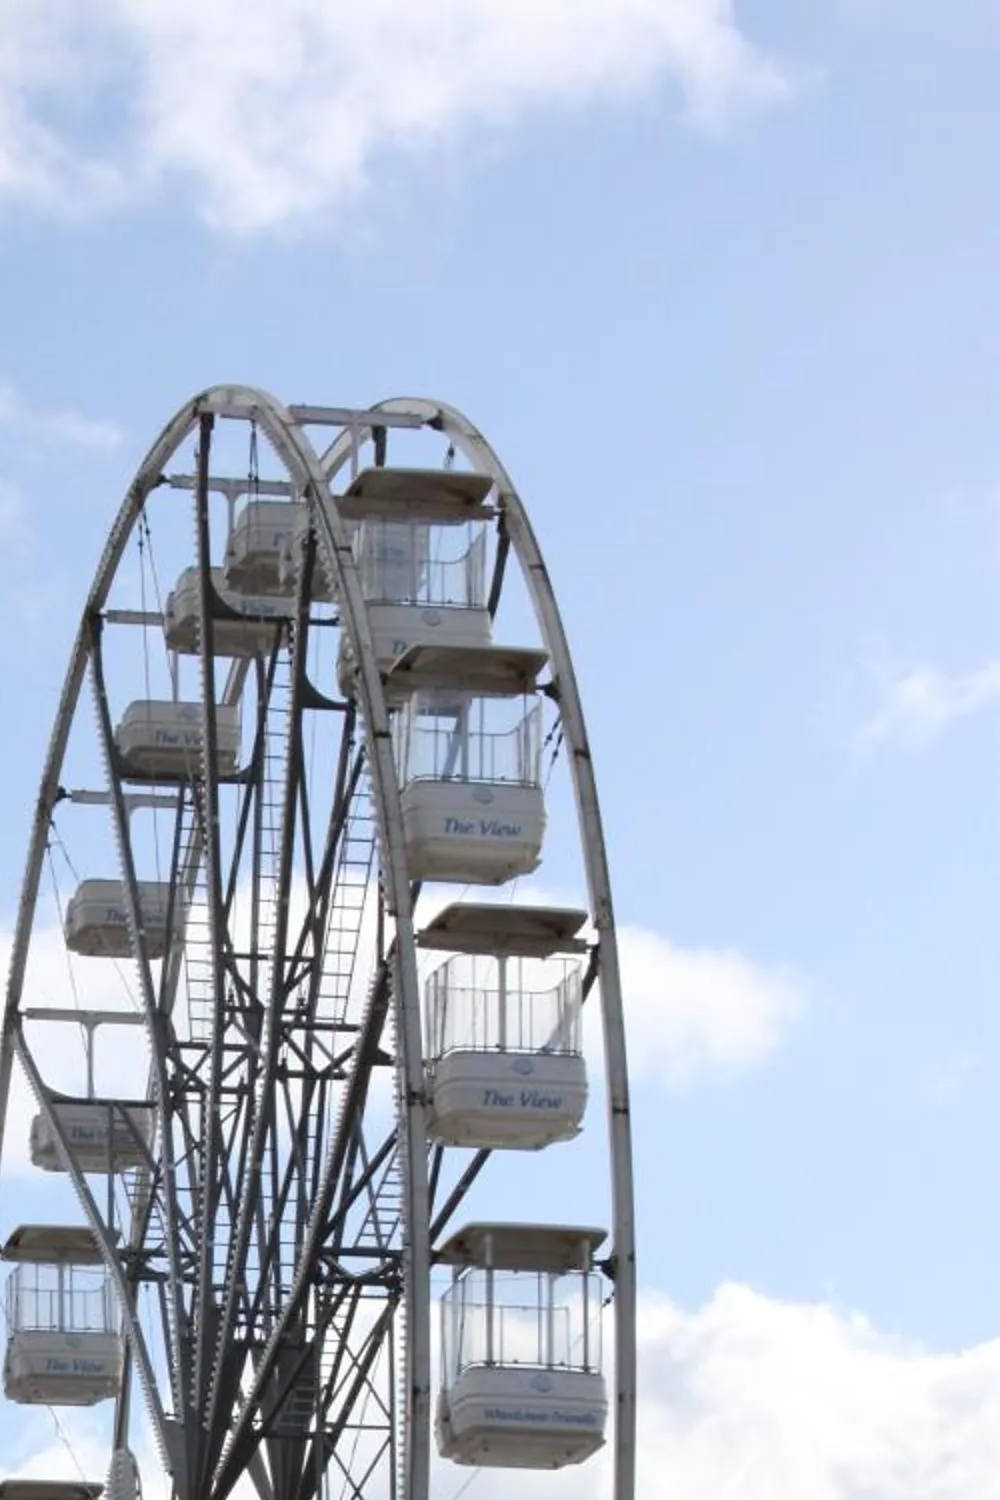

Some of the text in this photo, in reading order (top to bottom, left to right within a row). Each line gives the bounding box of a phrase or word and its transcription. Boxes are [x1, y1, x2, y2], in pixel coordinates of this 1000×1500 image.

[154, 730, 179, 744] The
[444, 817, 522, 837] The View
[483, 1089, 563, 1108] The View
[45, 1359, 105, 1372] The View
